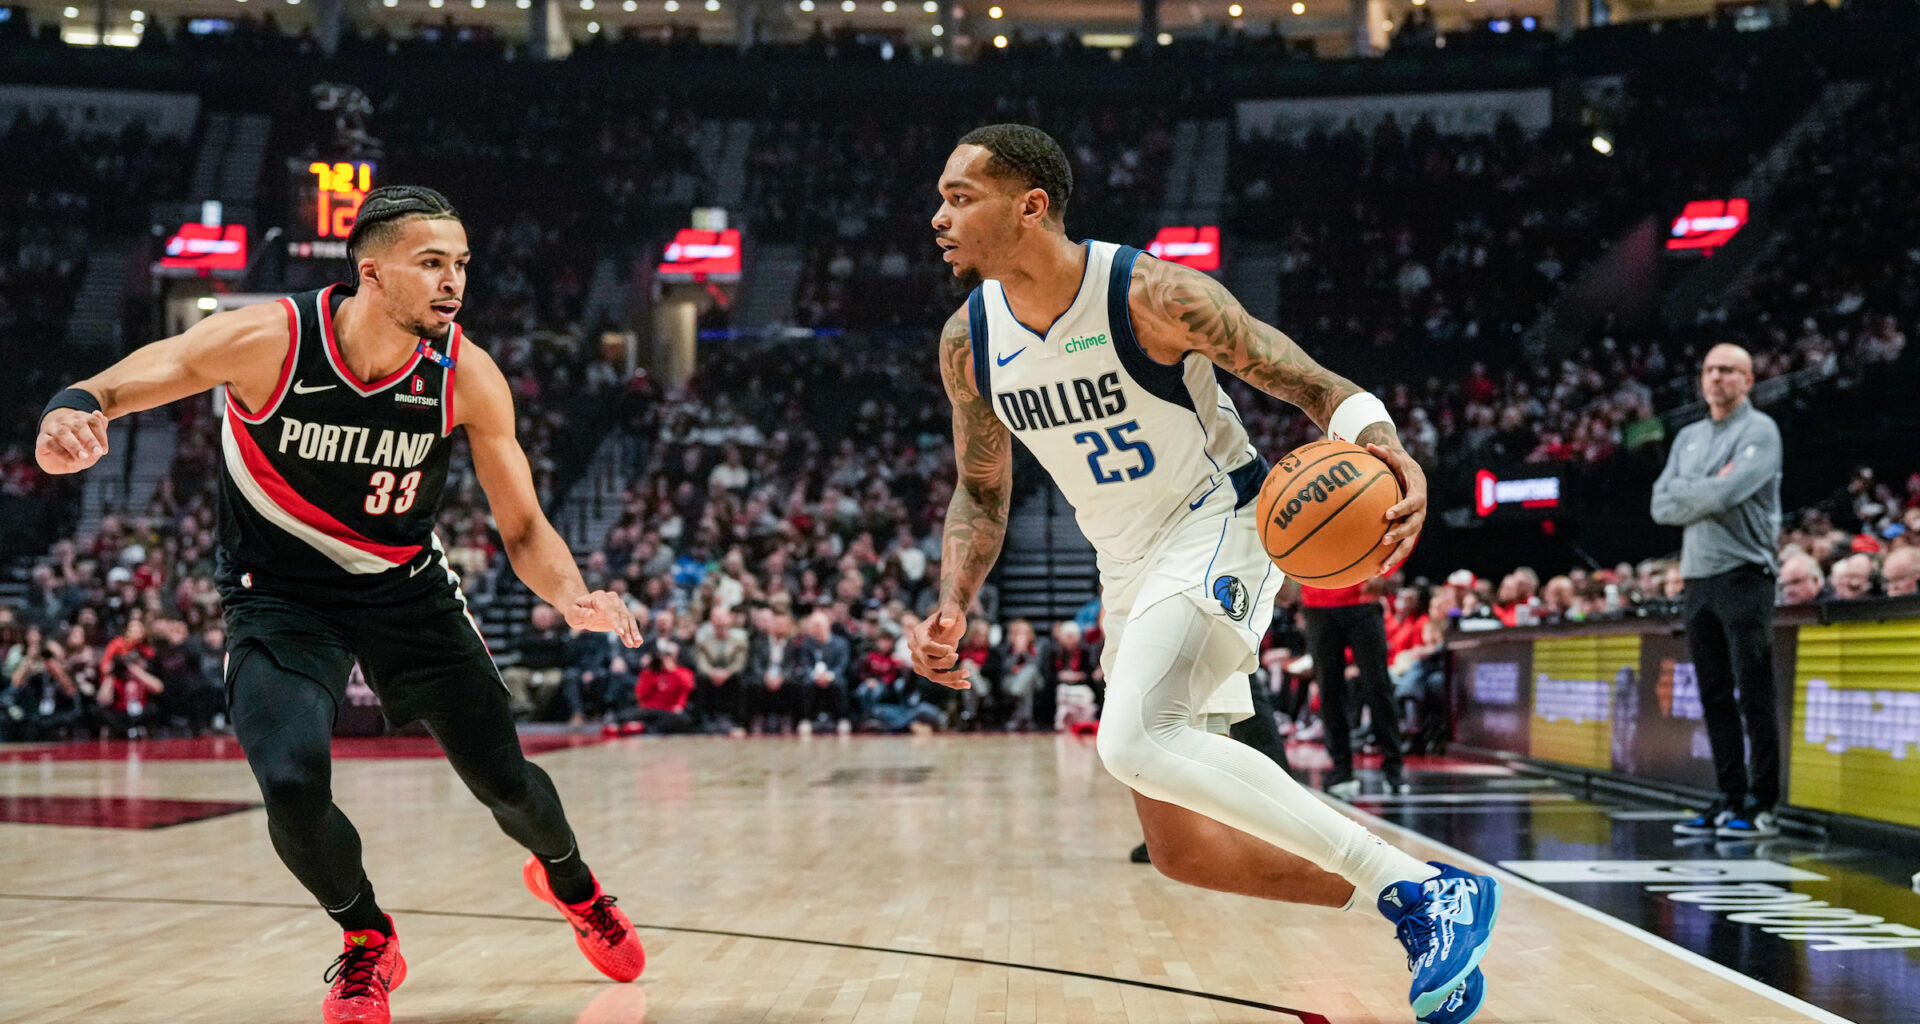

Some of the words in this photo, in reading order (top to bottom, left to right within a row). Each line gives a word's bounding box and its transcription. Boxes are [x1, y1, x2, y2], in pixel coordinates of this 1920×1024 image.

[430, 351, 442, 364] 32
[1065, 333, 1108, 354] chime
[394, 393, 439, 407] BRIGHTSIDE
[415, 378, 424, 392] B
[996, 369, 1128, 432] DALLAS
[278, 416, 435, 469] PORTLAND
[1073, 418, 1157, 485] 25
[363, 470, 423, 515] 33
[1273, 460, 1363, 531] Wilson
